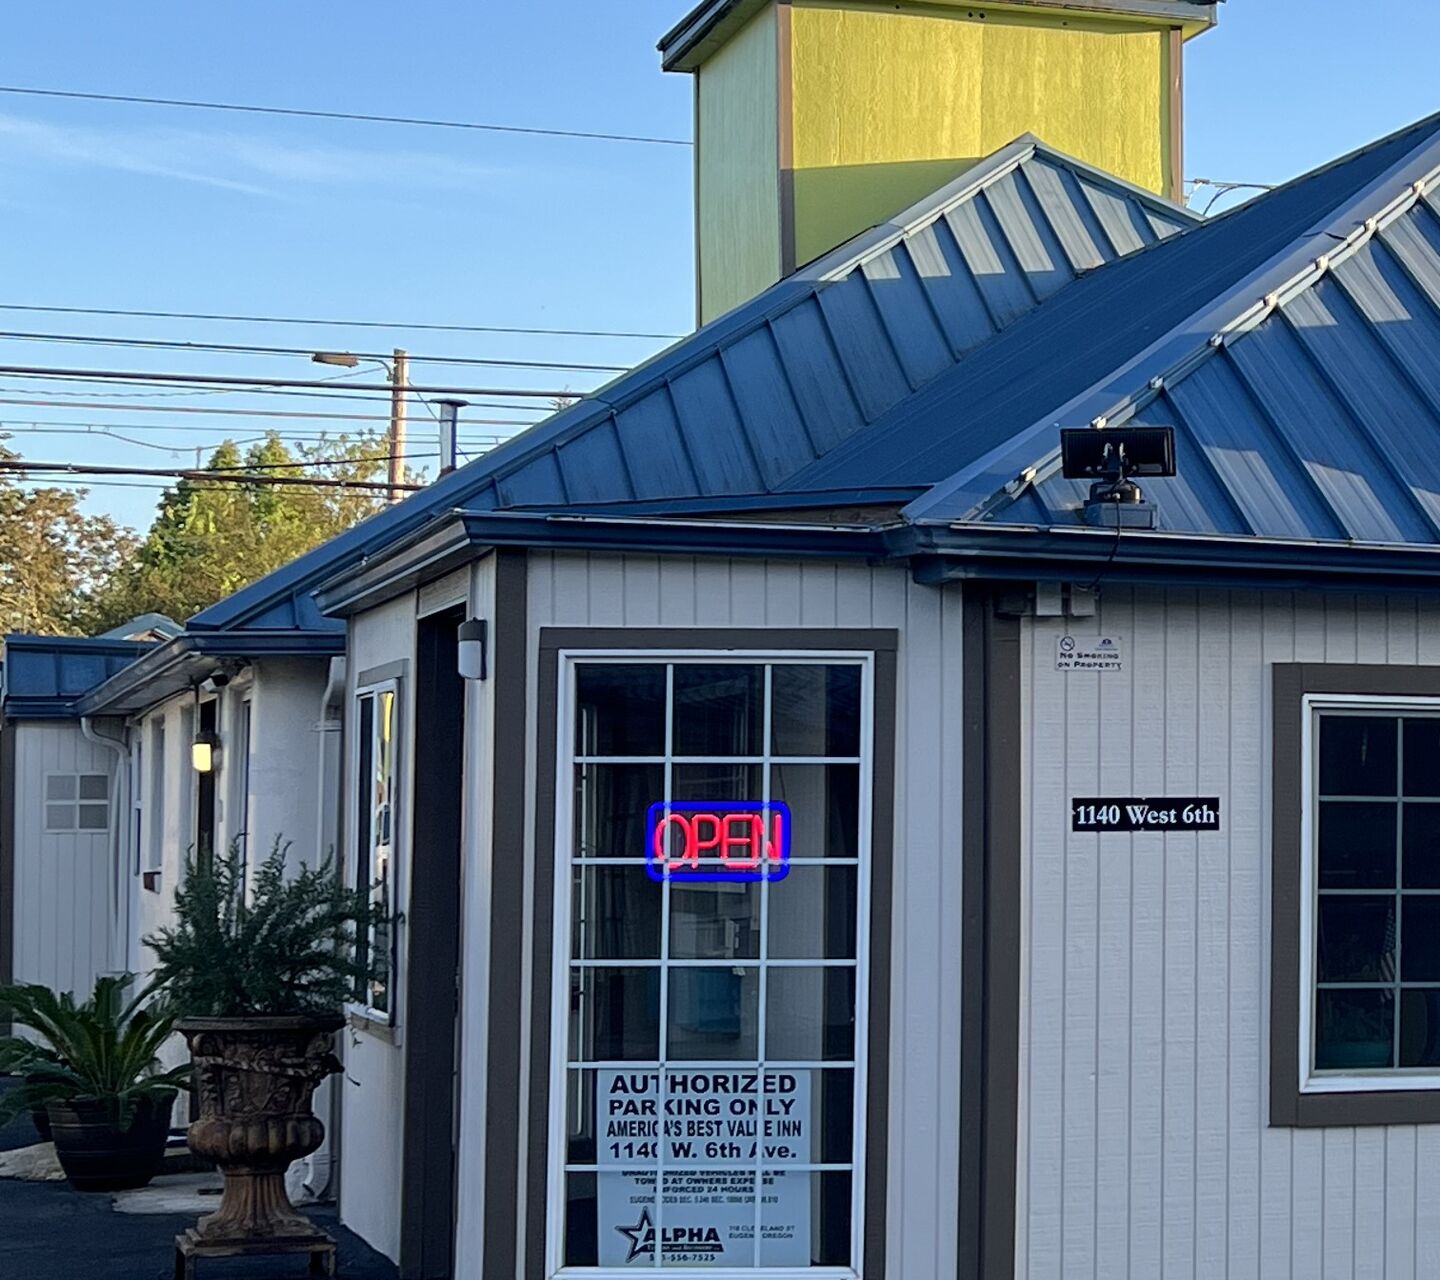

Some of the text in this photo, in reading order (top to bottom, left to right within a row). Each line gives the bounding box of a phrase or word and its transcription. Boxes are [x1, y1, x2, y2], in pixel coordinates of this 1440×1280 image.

[1076, 804, 1216, 824] 1140 West 6th
[654, 814, 782, 869] OPEN
[609, 1074, 796, 1094] AUTHORIZED
[609, 1099, 721, 1115] PARKING
[687, 1120, 723, 1137] BEST
[777, 1120, 802, 1137] INN
[671, 1142, 697, 1158] W.
[705, 1142, 741, 1158] 6th
[643, 1228, 720, 1242] ALPHA
